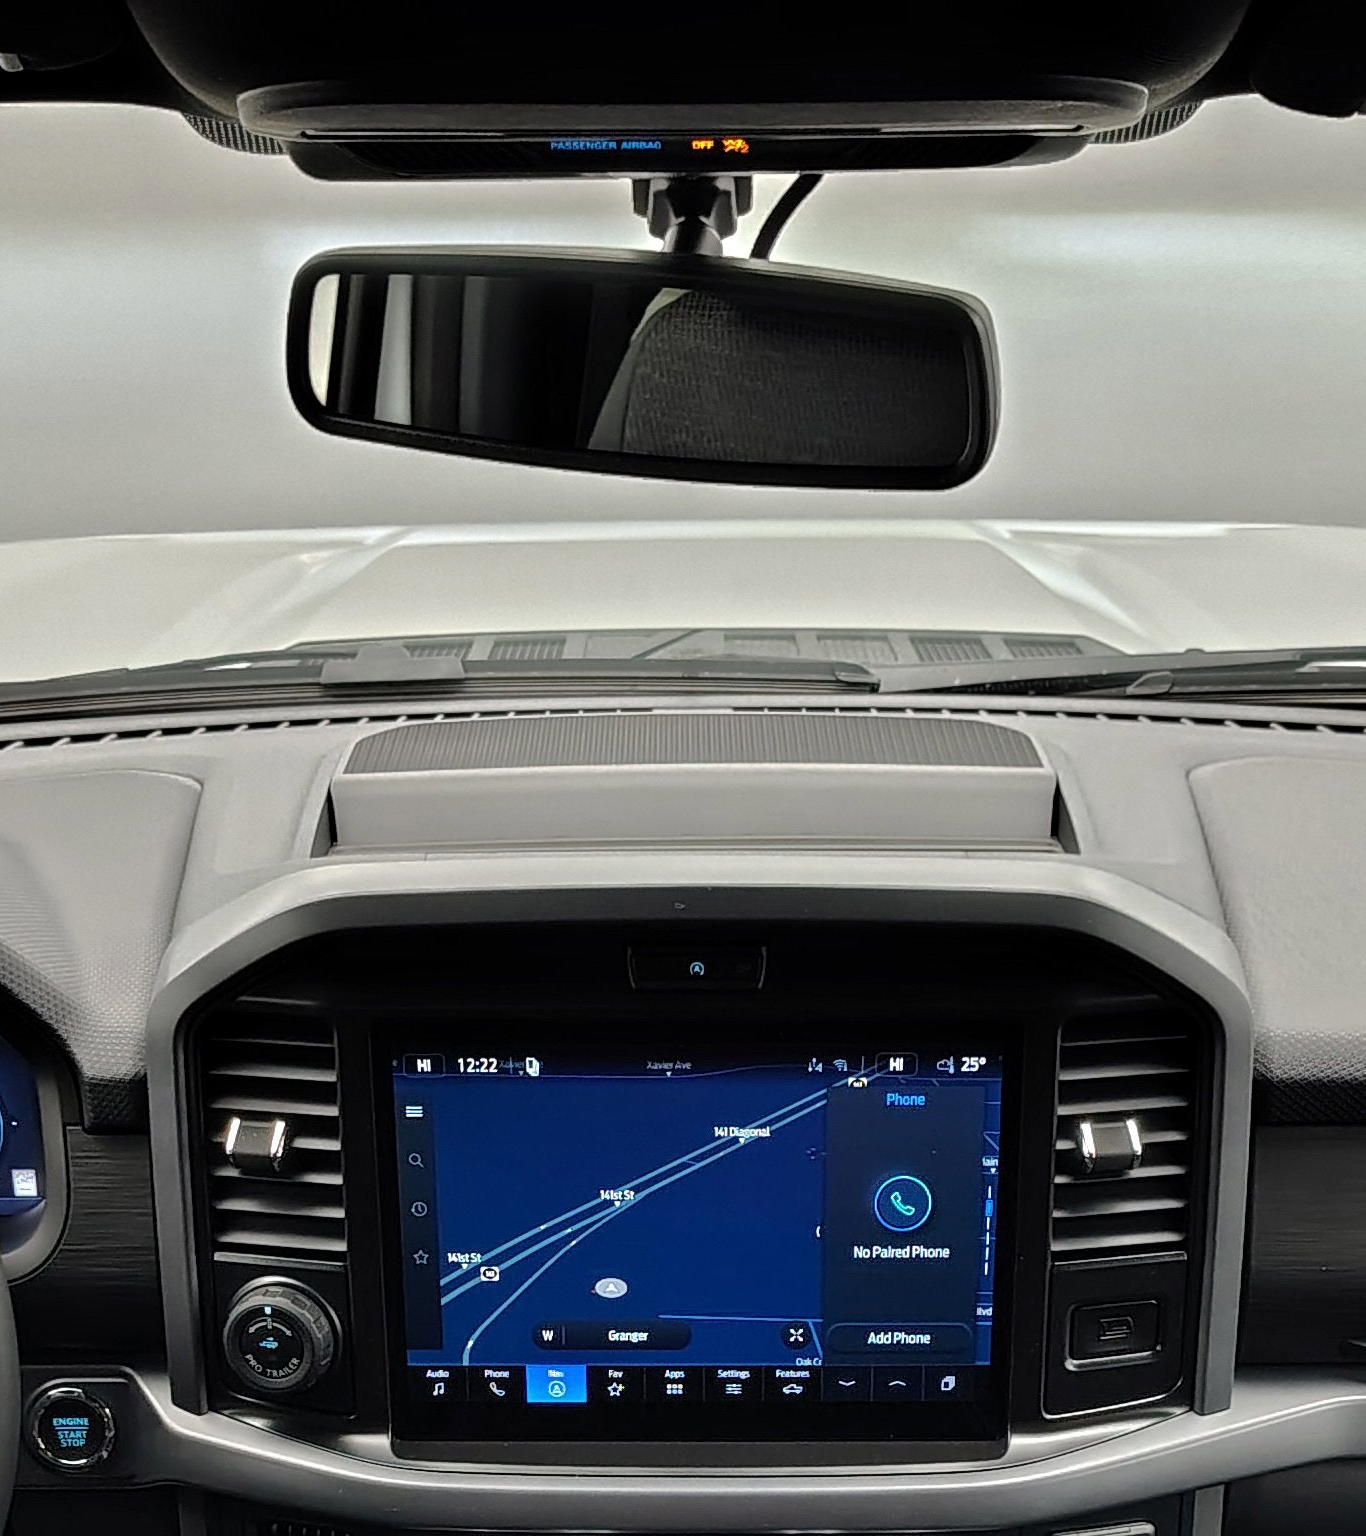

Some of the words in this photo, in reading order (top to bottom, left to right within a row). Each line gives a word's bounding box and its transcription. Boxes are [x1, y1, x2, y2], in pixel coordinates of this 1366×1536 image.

[550, 141, 617, 150] PASSENGER
[620, 141, 662, 150] AIRBAG
[691, 140, 715, 150] OFF
[417, 1059, 432, 1073] HI
[458, 1058, 498, 1073] 12:22
[889, 1058, 904, 1072] HI
[886, 1093, 926, 1106] Phone
[729, 1125, 771, 1139] Diagonal
[599, 1189, 622, 1200] 141st
[623, 1189, 635, 1200] St
[469, 1252, 482, 1263] St
[853, 1246, 870, 1259] No
[872, 1245, 910, 1258] Paired
[912, 1245, 950, 1258] Phone
[542, 1330, 554, 1342] W
[608, 1330, 649, 1343] Granger
[867, 1332, 892, 1345] Add
[893, 1332, 931, 1345] Phone
[244, 1353, 263, 1373] PRO
[265, 1357, 301, 1378] TRAILER
[426, 1369, 450, 1379] Audio
[484, 1369, 510, 1379] Phone
[608, 1369, 623, 1379] Fav
[664, 1369, 685, 1380] Apps
[717, 1369, 751, 1380] Settings
[775, 1369, 810, 1379] Features
[52, 1417, 90, 1426] ENGINE
[57, 1430, 88, 1439] START
[60, 1439, 86, 1447] STOP
